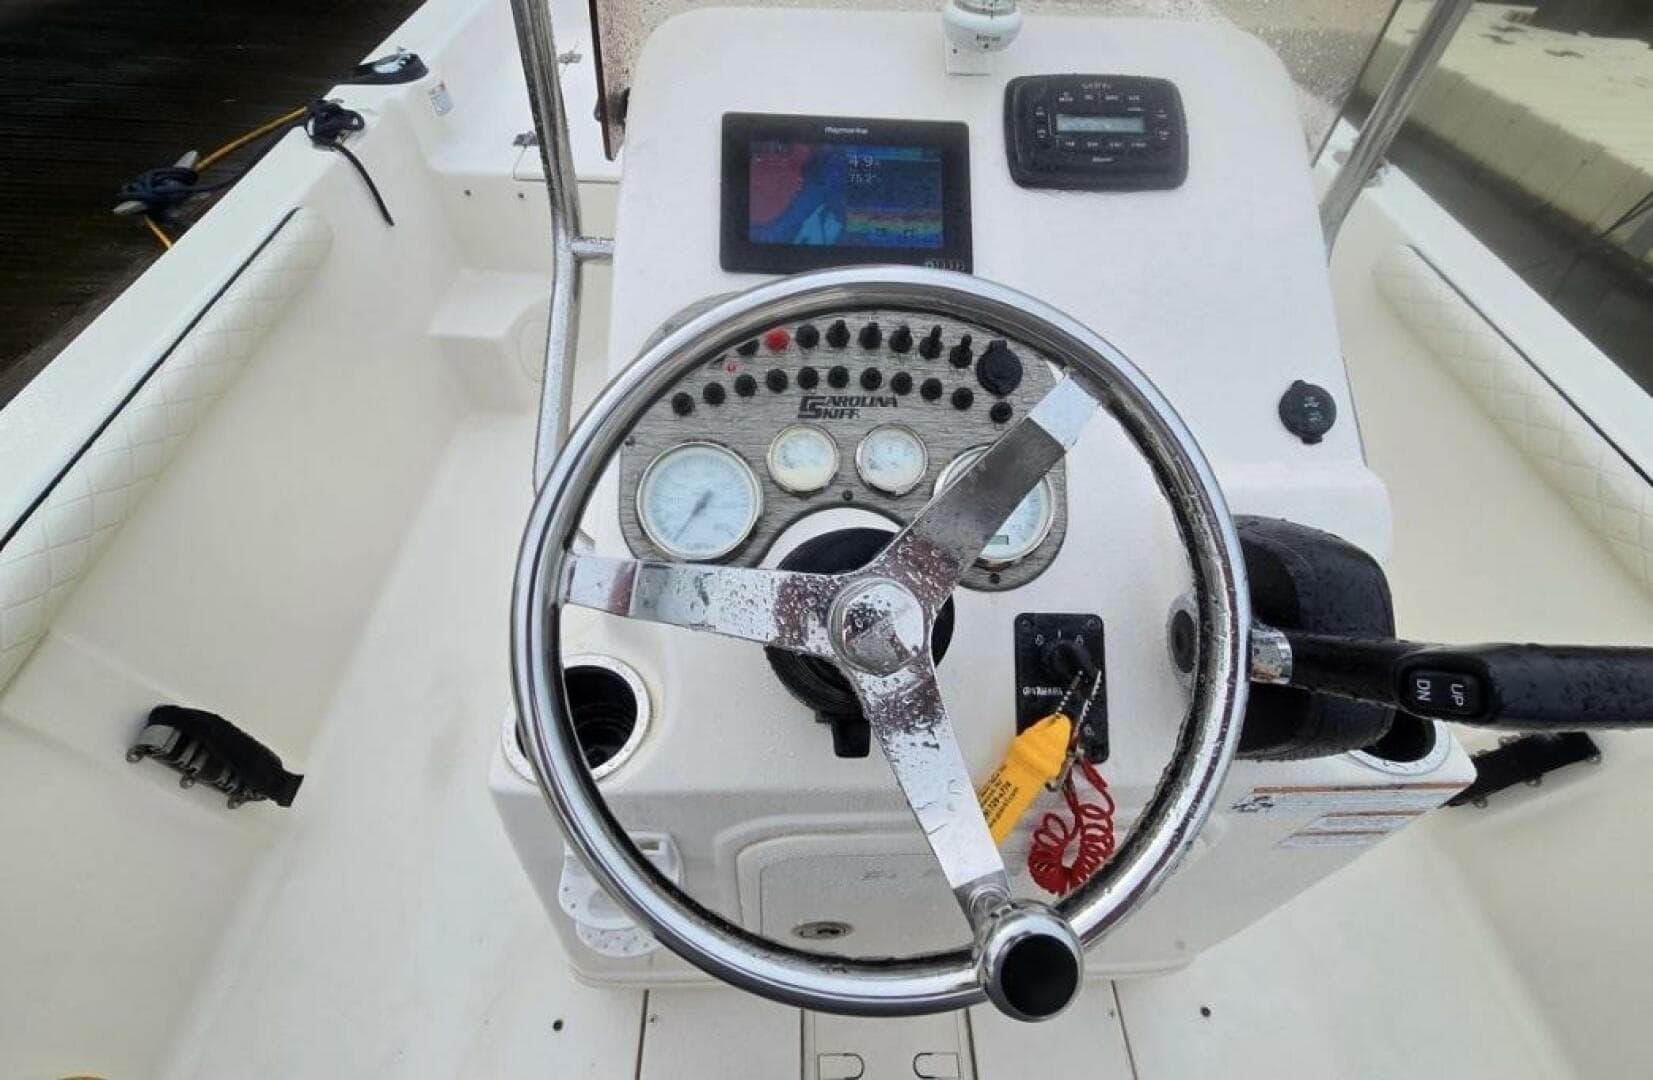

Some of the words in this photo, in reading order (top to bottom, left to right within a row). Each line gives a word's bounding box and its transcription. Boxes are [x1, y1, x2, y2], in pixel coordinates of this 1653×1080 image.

[799, 395, 898, 411] CAROLINA
[1416, 678, 1431, 701] DN
[1451, 683, 1464, 707] UP
